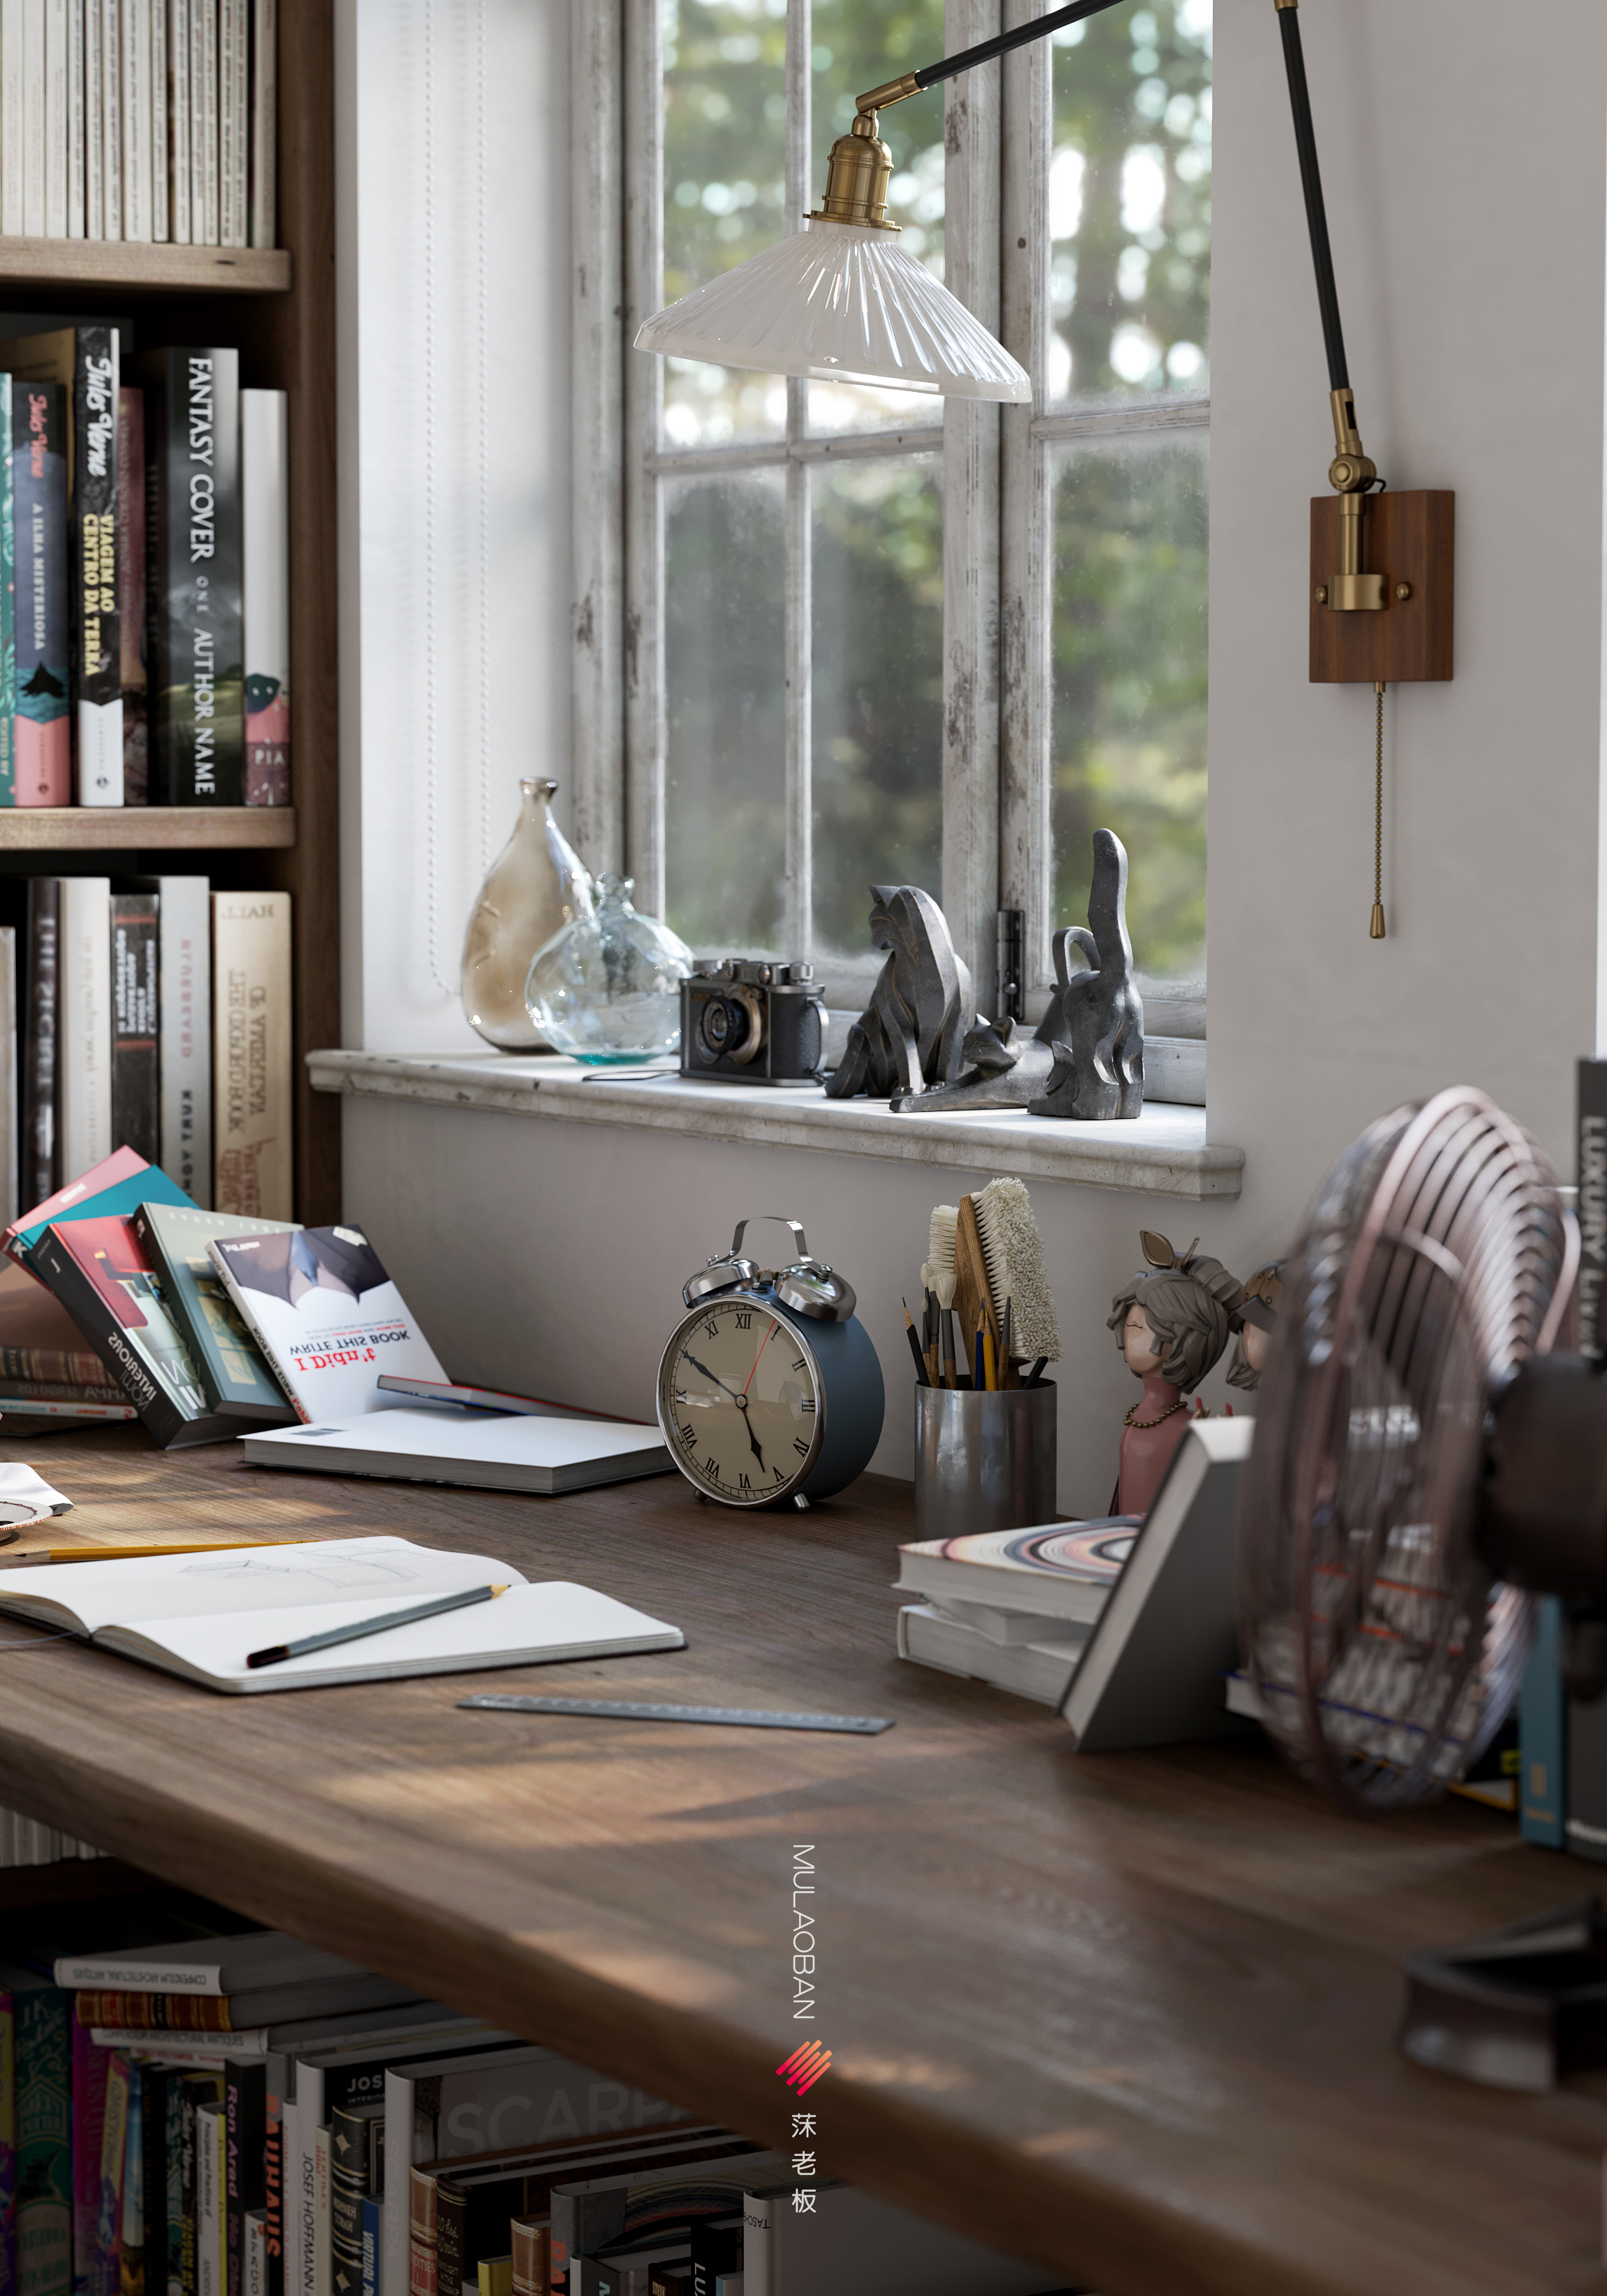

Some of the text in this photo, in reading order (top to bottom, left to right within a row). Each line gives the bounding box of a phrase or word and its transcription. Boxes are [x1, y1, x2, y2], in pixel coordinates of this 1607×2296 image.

[86, 356, 113, 478] Jules Verne
[99, 514, 116, 613] VIAGEM AO
[189, 357, 216, 796] FANTASY COVER ONE AUTHOR NAME
[34, 558, 45, 651] MISTERIOSA
[83, 514, 101, 677] CENTRO DA TERRA
[1583, 1115, 1605, 1263] LUXURY
[704, 1319, 719, 1339] XI
[735, 1313, 751, 1329] XII
[682, 1424, 697, 1450] VIII
[705, 1457, 719, 1479] VII
[739, 1473, 751, 1489] VI
[227, 2084, 238, 2133] Ron
[227, 2138, 239, 2198] Arad
[228, 2213, 240, 2248] No
[303, 2152, 315, 2289] JOSEF HOFFMANN
[743, 2212, 771, 2229] TASCHE
[362, 2230, 374, 2281] VIRTUAL
